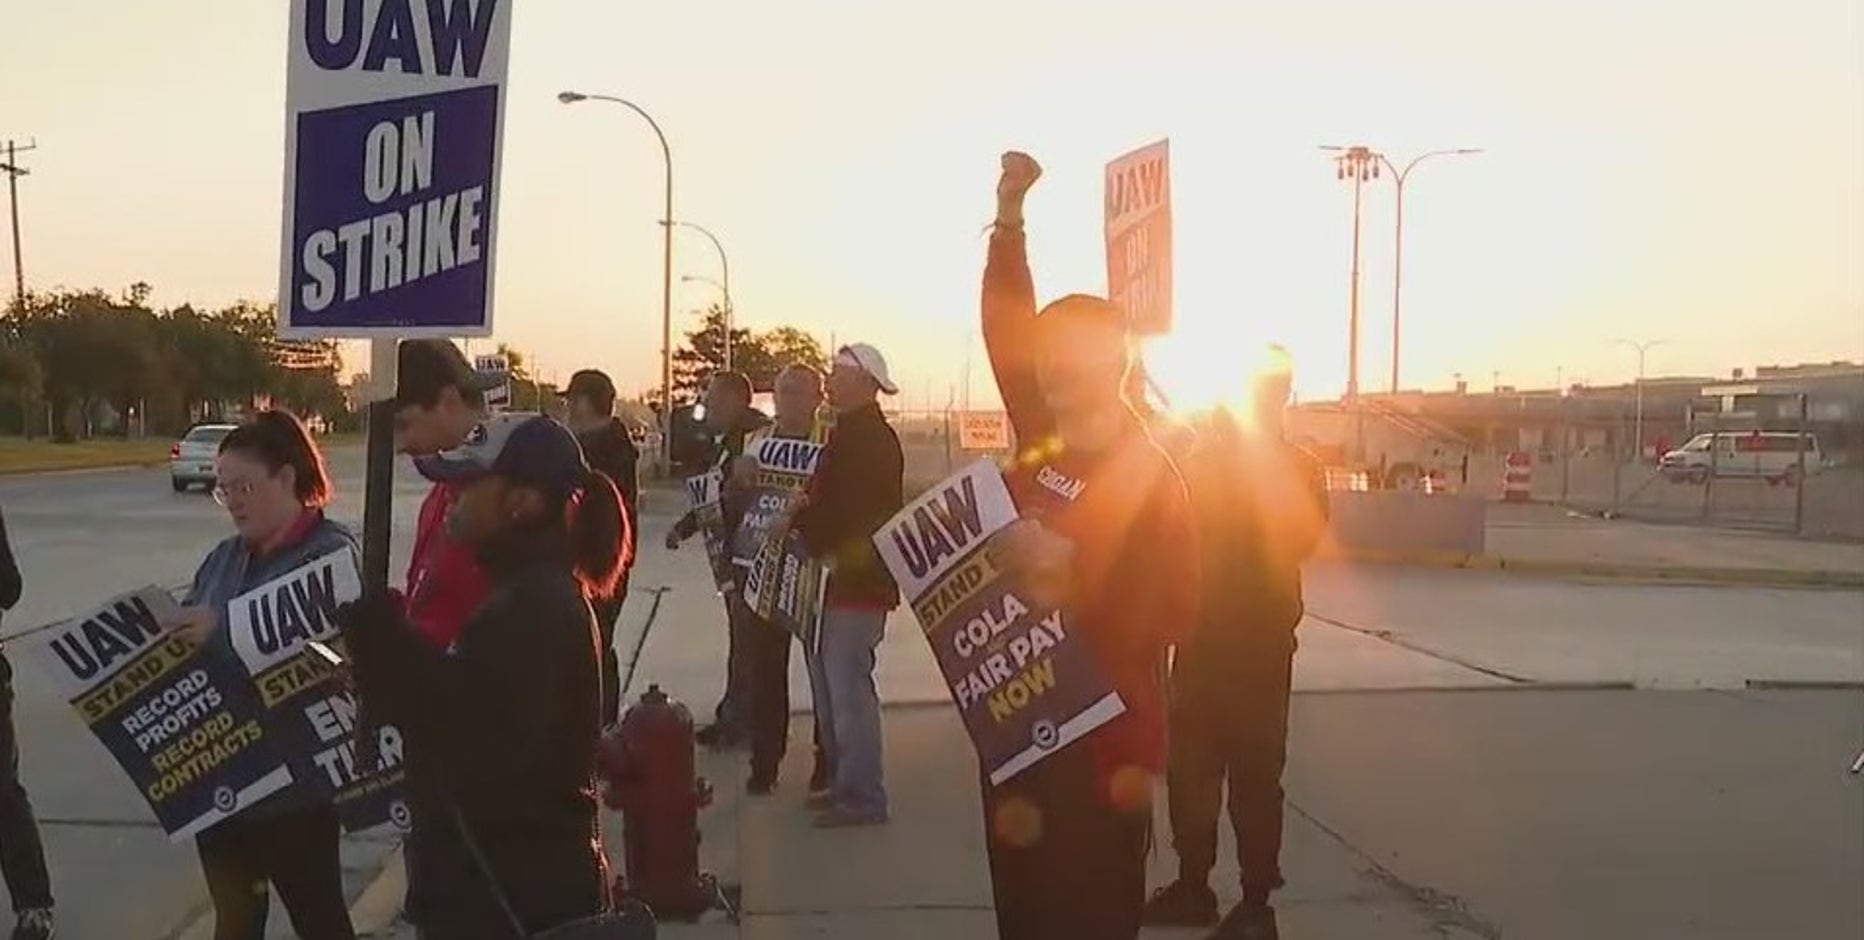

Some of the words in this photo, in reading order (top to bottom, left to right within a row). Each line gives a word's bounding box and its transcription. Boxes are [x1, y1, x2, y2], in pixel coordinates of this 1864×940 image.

[305, 0, 497, 78] UAW
[364, 110, 435, 204] ON
[1110, 157, 1164, 220] UAW
[302, 185, 483, 312] STRIKE
[759, 441, 819, 470] UAW
[760, 473, 796, 489] TAND
[759, 495, 788, 510] COL
[891, 475, 982, 579] UAW
[249, 564, 338, 655] UAW
[921, 569, 983, 626] STAND
[954, 593, 1028, 657] COLA
[50, 596, 161, 680] UAW
[955, 653, 1012, 709] FAIR
[1009, 609, 1066, 667] PAY
[82, 656, 164, 720] STAND
[122, 669, 208, 734] RECORD
[264, 648, 332, 699] STAN
[988, 658, 1056, 723] NOW
[136, 686, 222, 752] PROFITS
[152, 711, 233, 771] RECORD
[305, 691, 357, 743] EN
[149, 720, 263, 801] CONTRACTS
[314, 726, 403, 788] TIR
